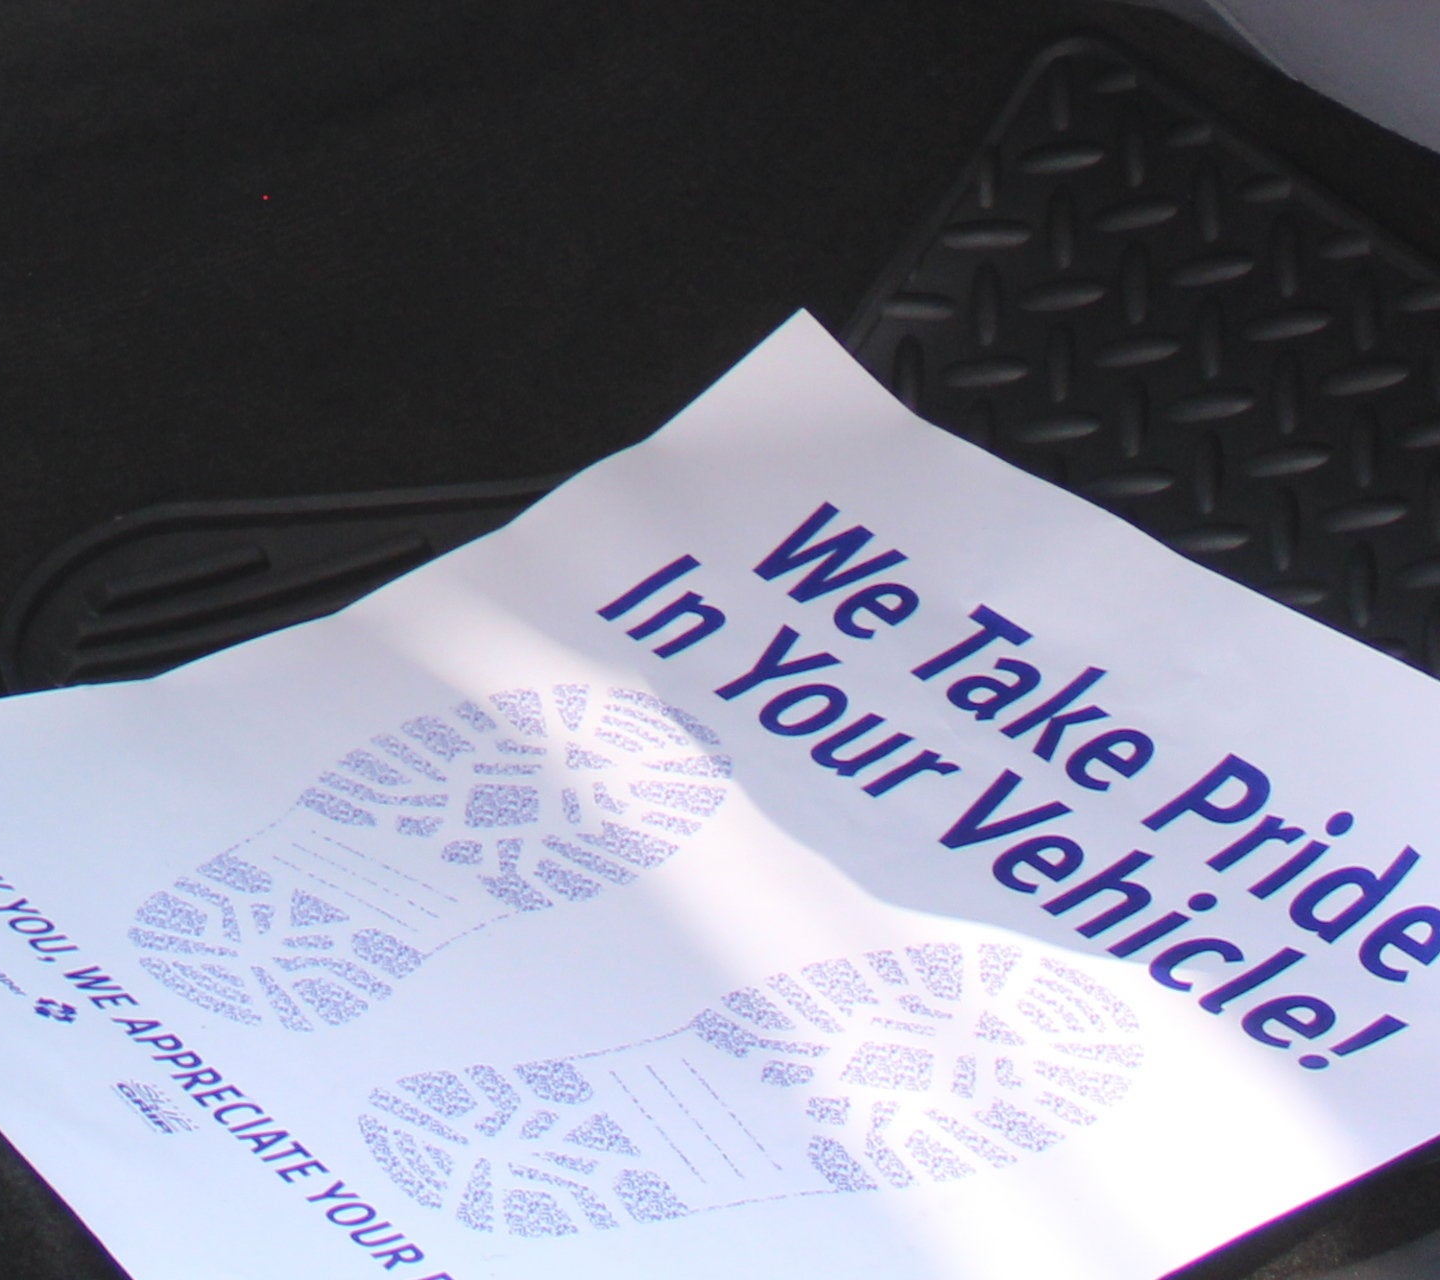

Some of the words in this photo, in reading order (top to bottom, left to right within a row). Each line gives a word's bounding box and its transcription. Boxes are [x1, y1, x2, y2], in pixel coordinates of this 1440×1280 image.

[751, 501, 920, 640] We
[910, 604, 1155, 792] Take
[596, 553, 728, 660] In
[713, 625, 960, 799] Your
[937, 768, 1409, 1071] Vehicle!
[63, 965, 140, 1010] WE
[109, 1016, 331, 1184] APPRECIATE
[305, 1179, 426, 1271] YOUR
